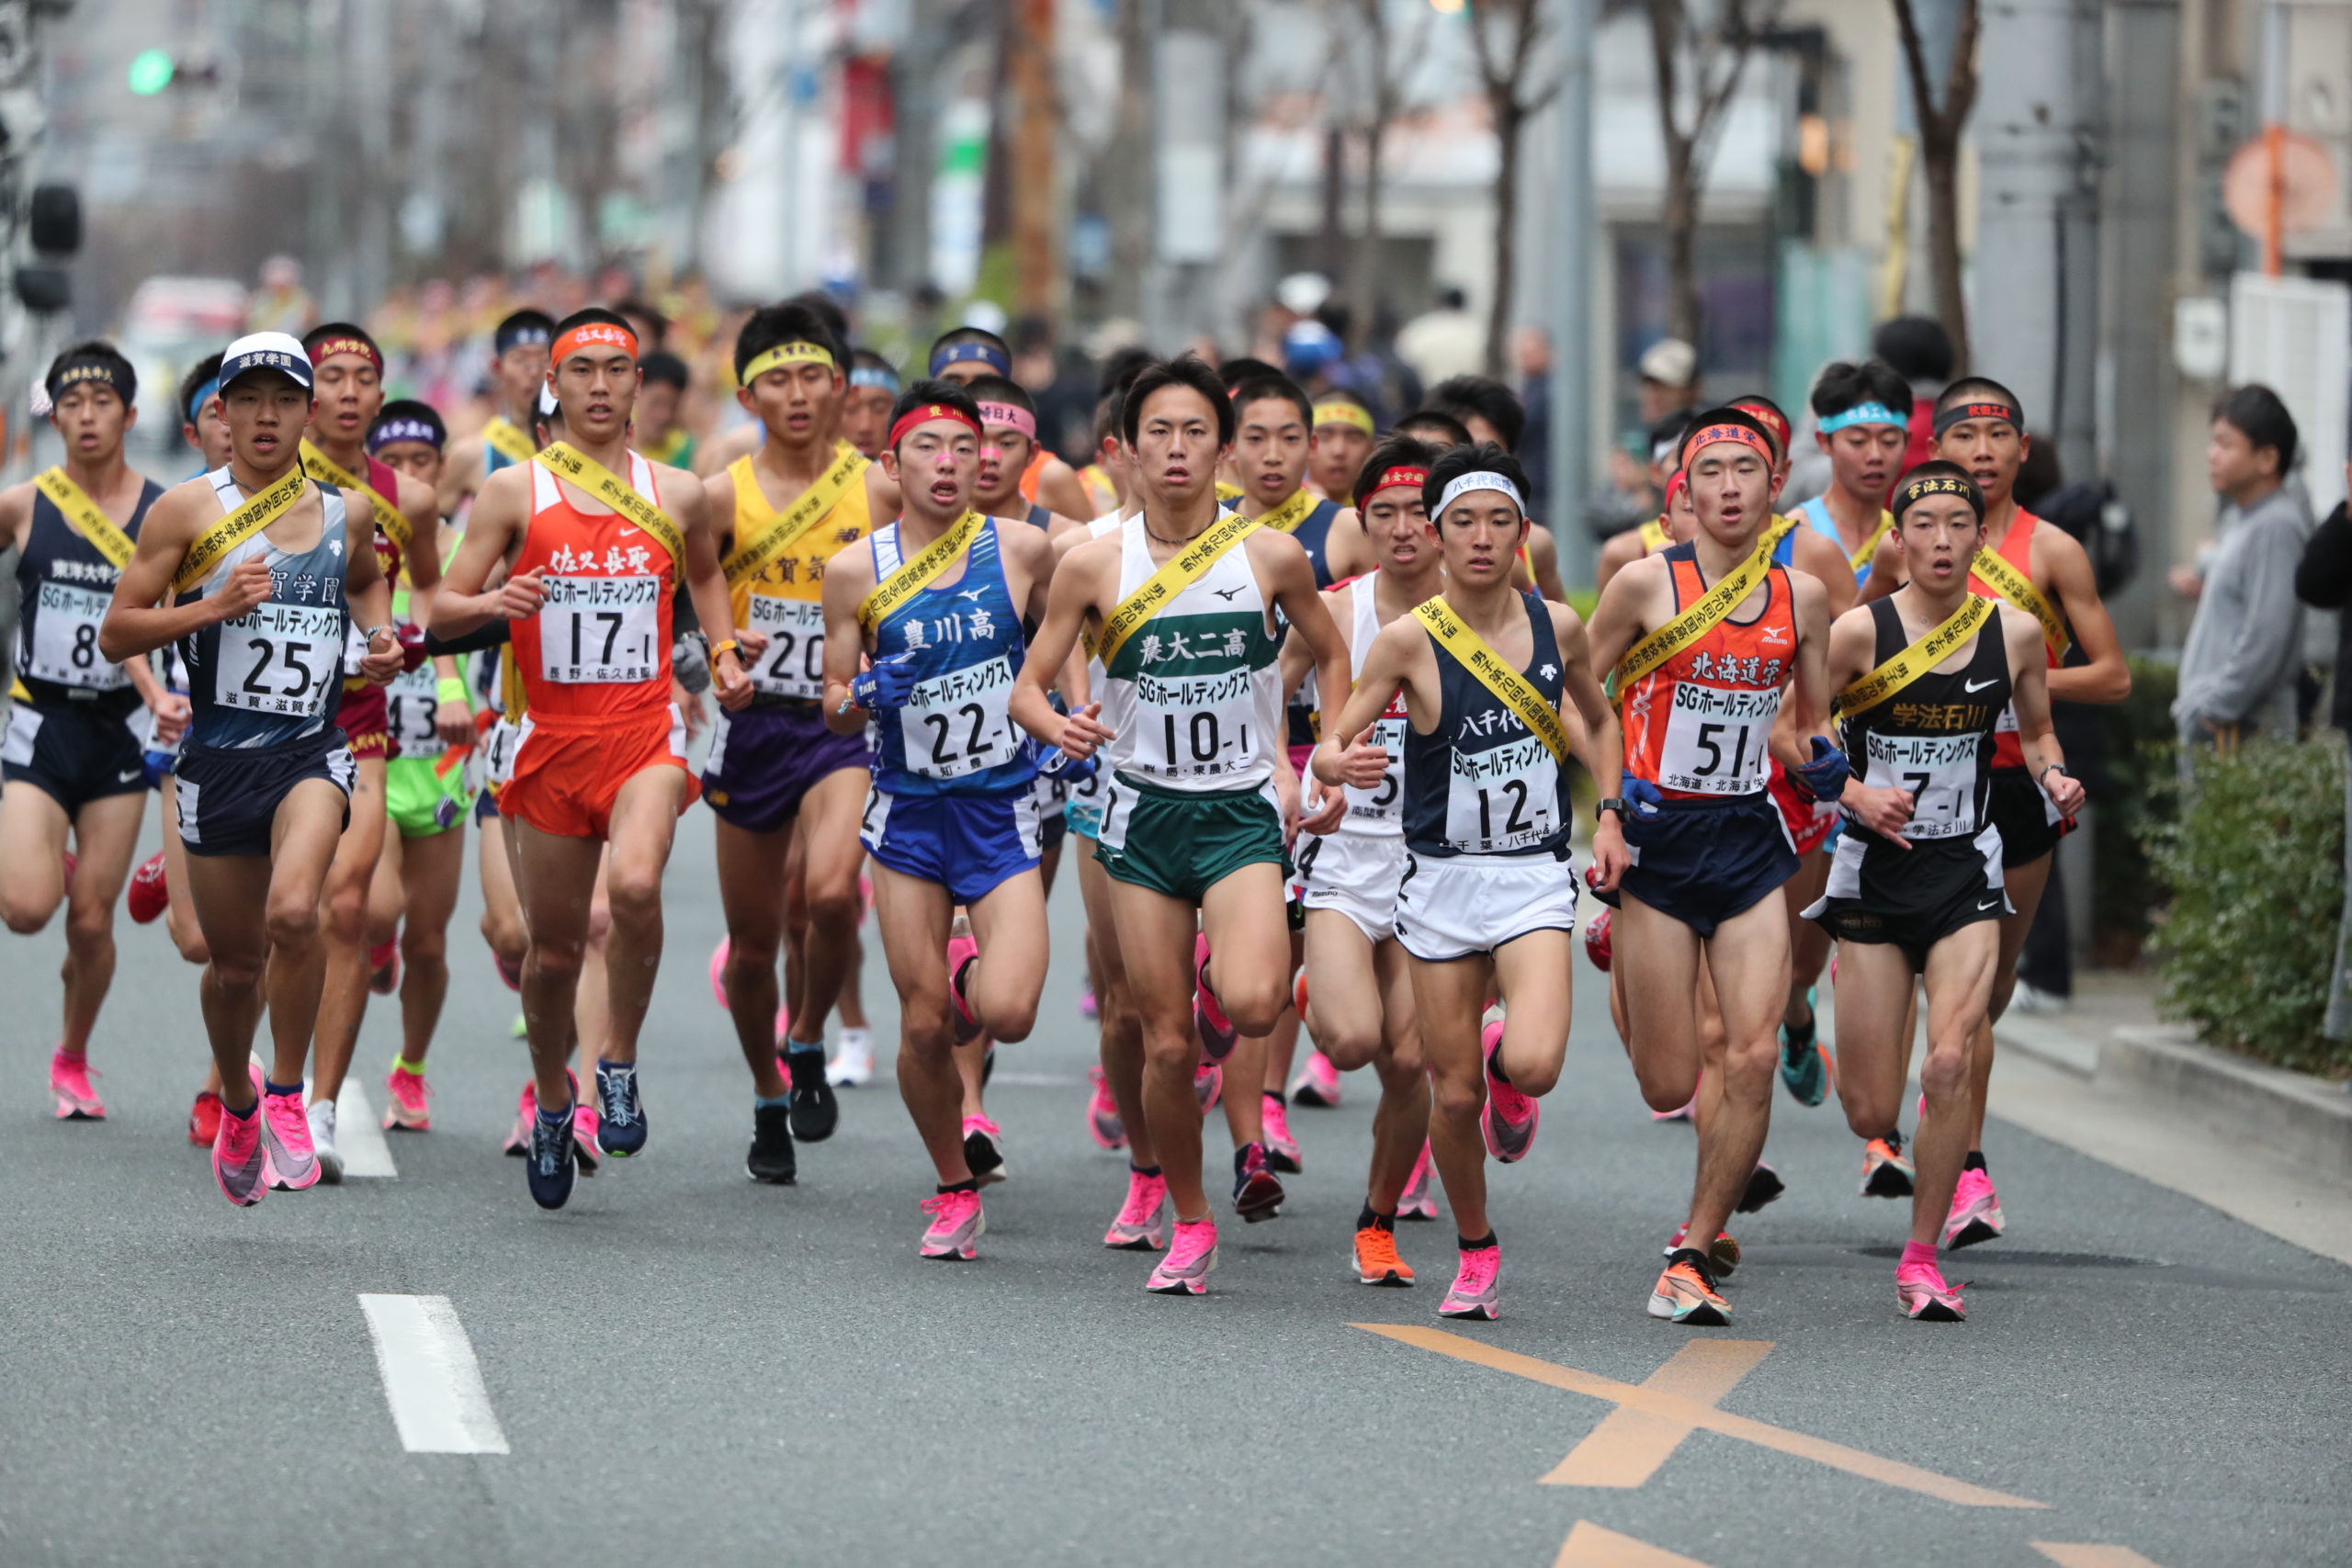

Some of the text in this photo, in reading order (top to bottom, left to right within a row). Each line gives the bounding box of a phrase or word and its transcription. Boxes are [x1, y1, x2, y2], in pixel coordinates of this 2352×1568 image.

[322, 340, 371, 358] 九州学院
[575, 328, 627, 346] 佐久長聖
[239, 353, 292, 368] 滋賀学園
[929, 405, 962, 419] 豊川
[1694, 427, 1756, 446] 北海道栄
[1908, 479, 1970, 499] 学法石川
[549, 544, 650, 575] 佐久長聖
[72, 624, 96, 669] 8
[571, 612, 650, 666] 17-1
[904, 607, 995, 651] 豊川高
[769, 631, 825, 681] 20
[1139, 628, 1247, 667] 農大二高
[1691, 651, 1782, 687] 北海道栄
[1138, 671, 1250, 706] SGホールディングス
[1676, 683, 1779, 718] SGホールディングス
[923, 703, 1017, 764] 22-1
[1893, 703, 1988, 730] 学法石川
[1164, 711, 1248, 765] 10-1
[1692, 722, 1764, 778] 51-1
[1869, 735, 1975, 765] SGホールディングス
